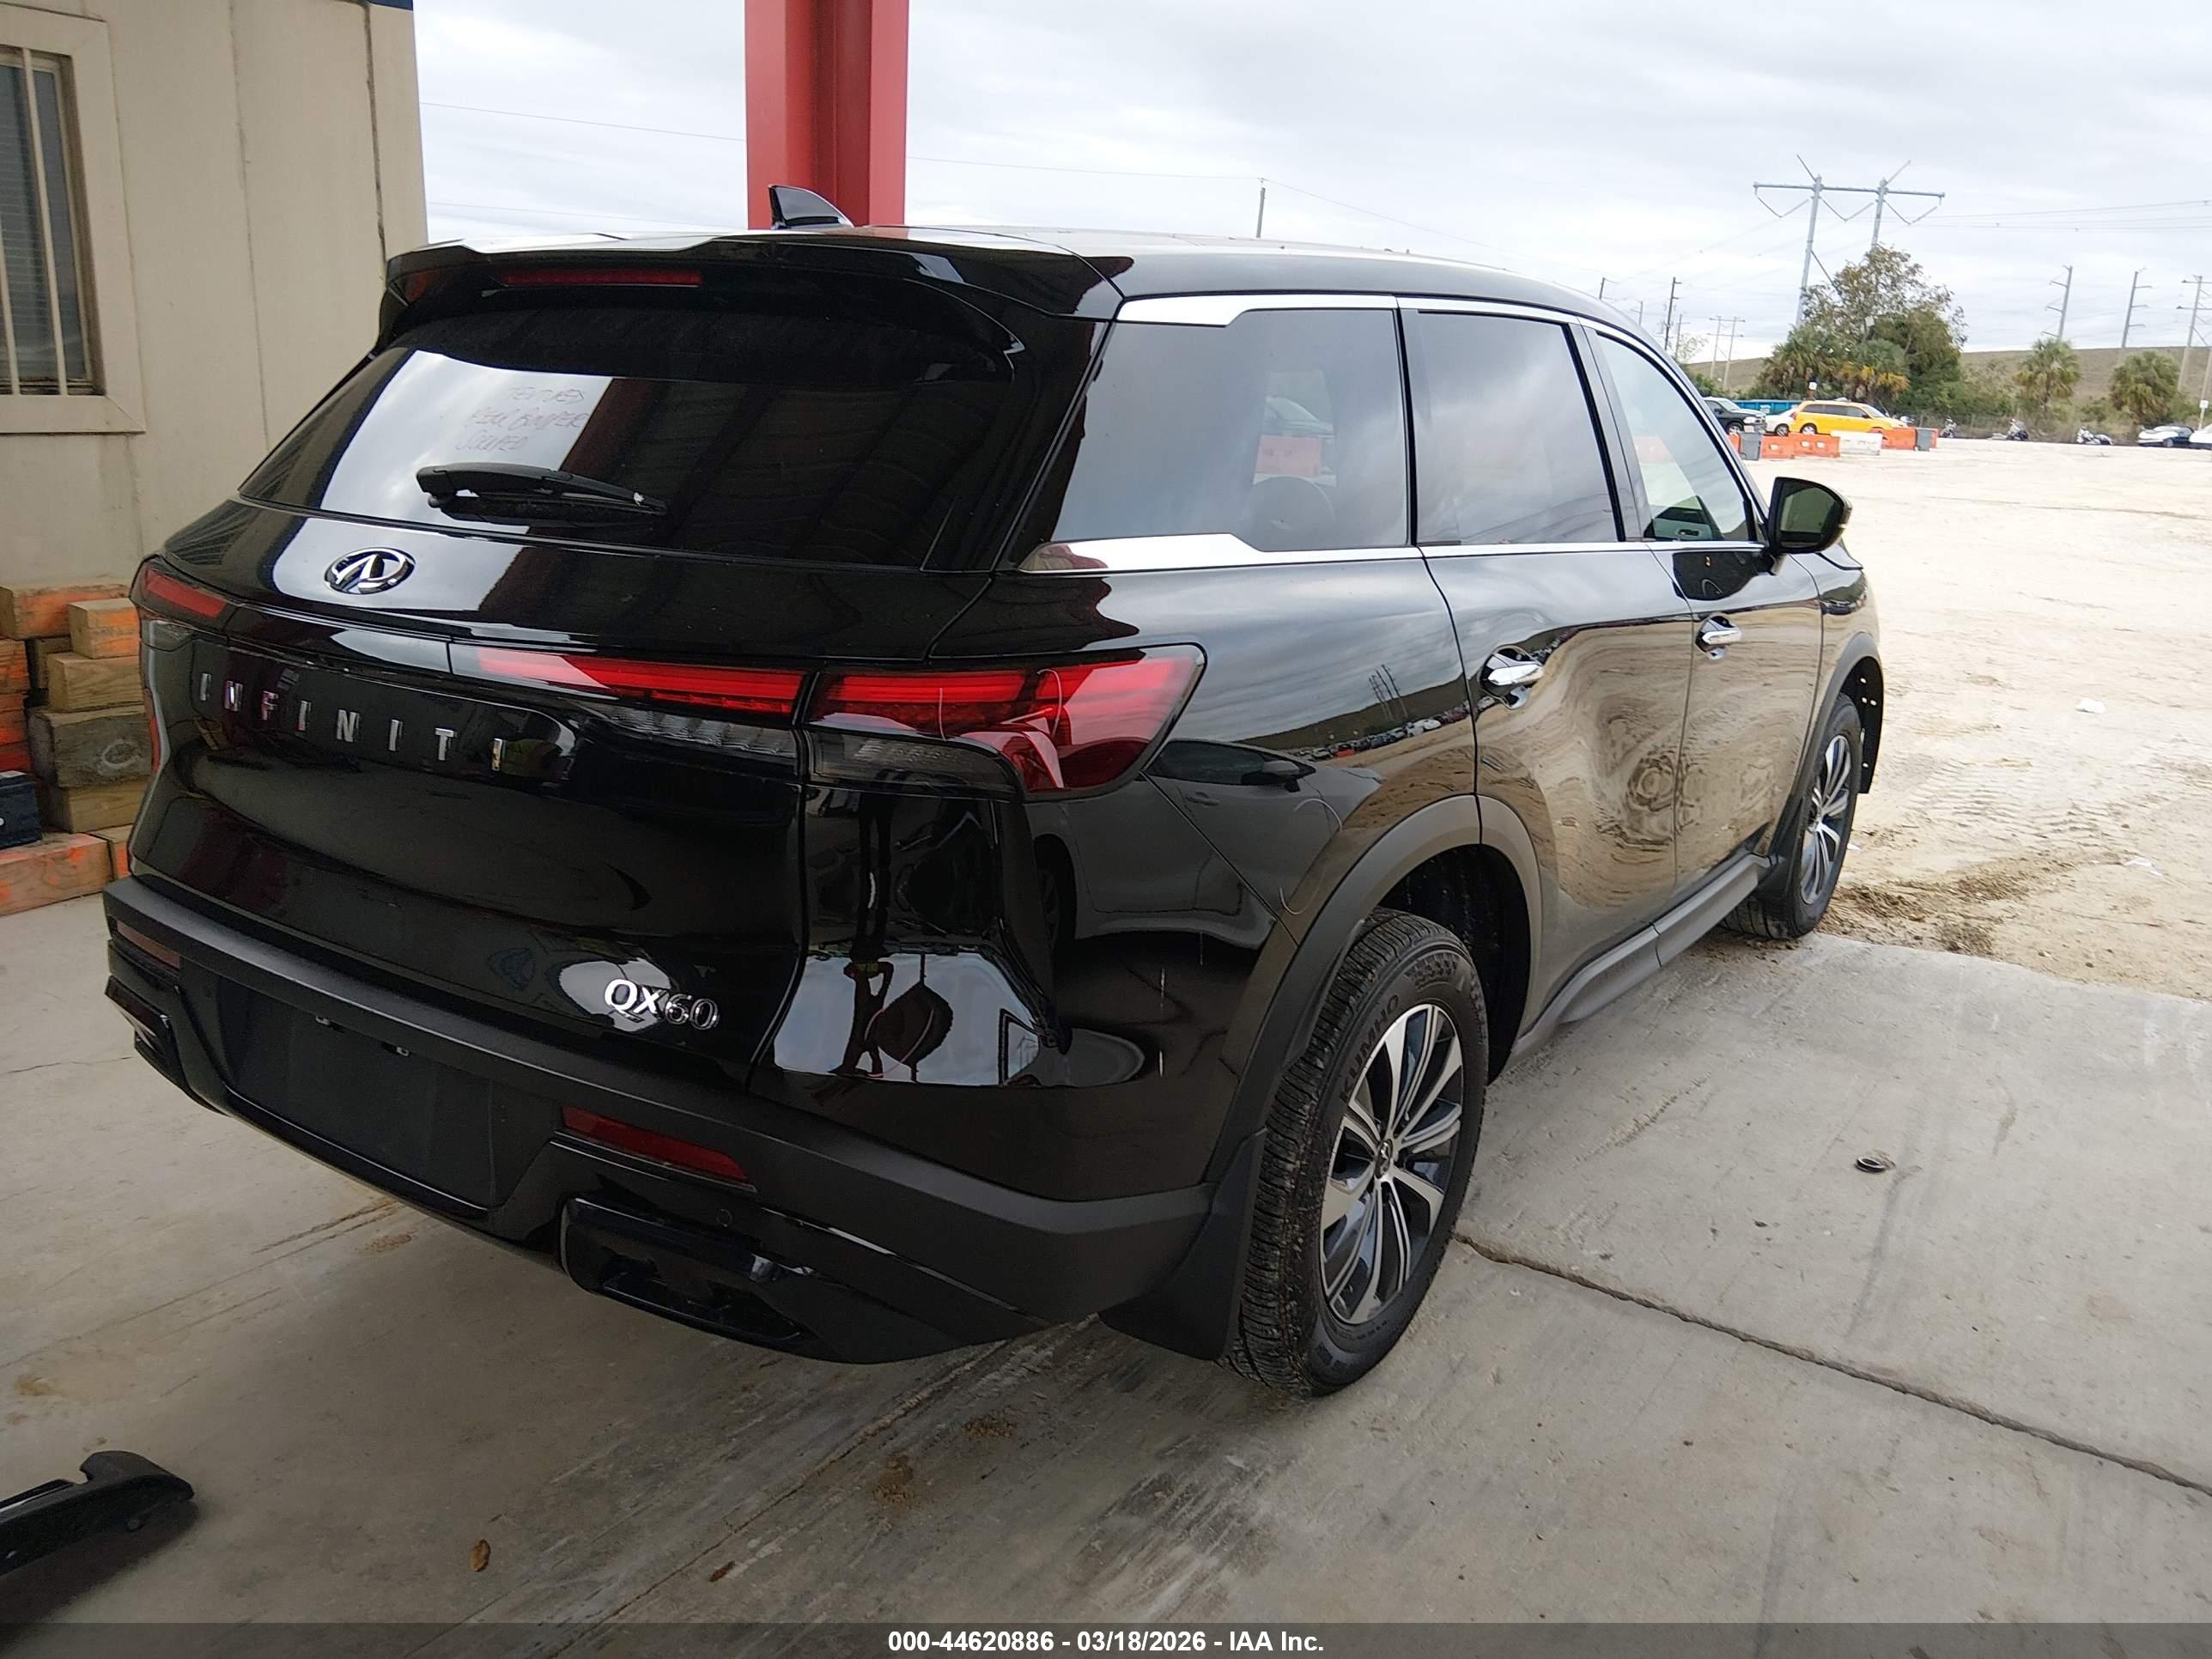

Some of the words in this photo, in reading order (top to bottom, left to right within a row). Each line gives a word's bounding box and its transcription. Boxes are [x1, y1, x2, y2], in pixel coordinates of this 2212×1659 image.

[199, 672, 507, 771] INFINITI
[605, 978, 720, 1030] QX60
[1339, 994, 1400, 1104] KUMHO
